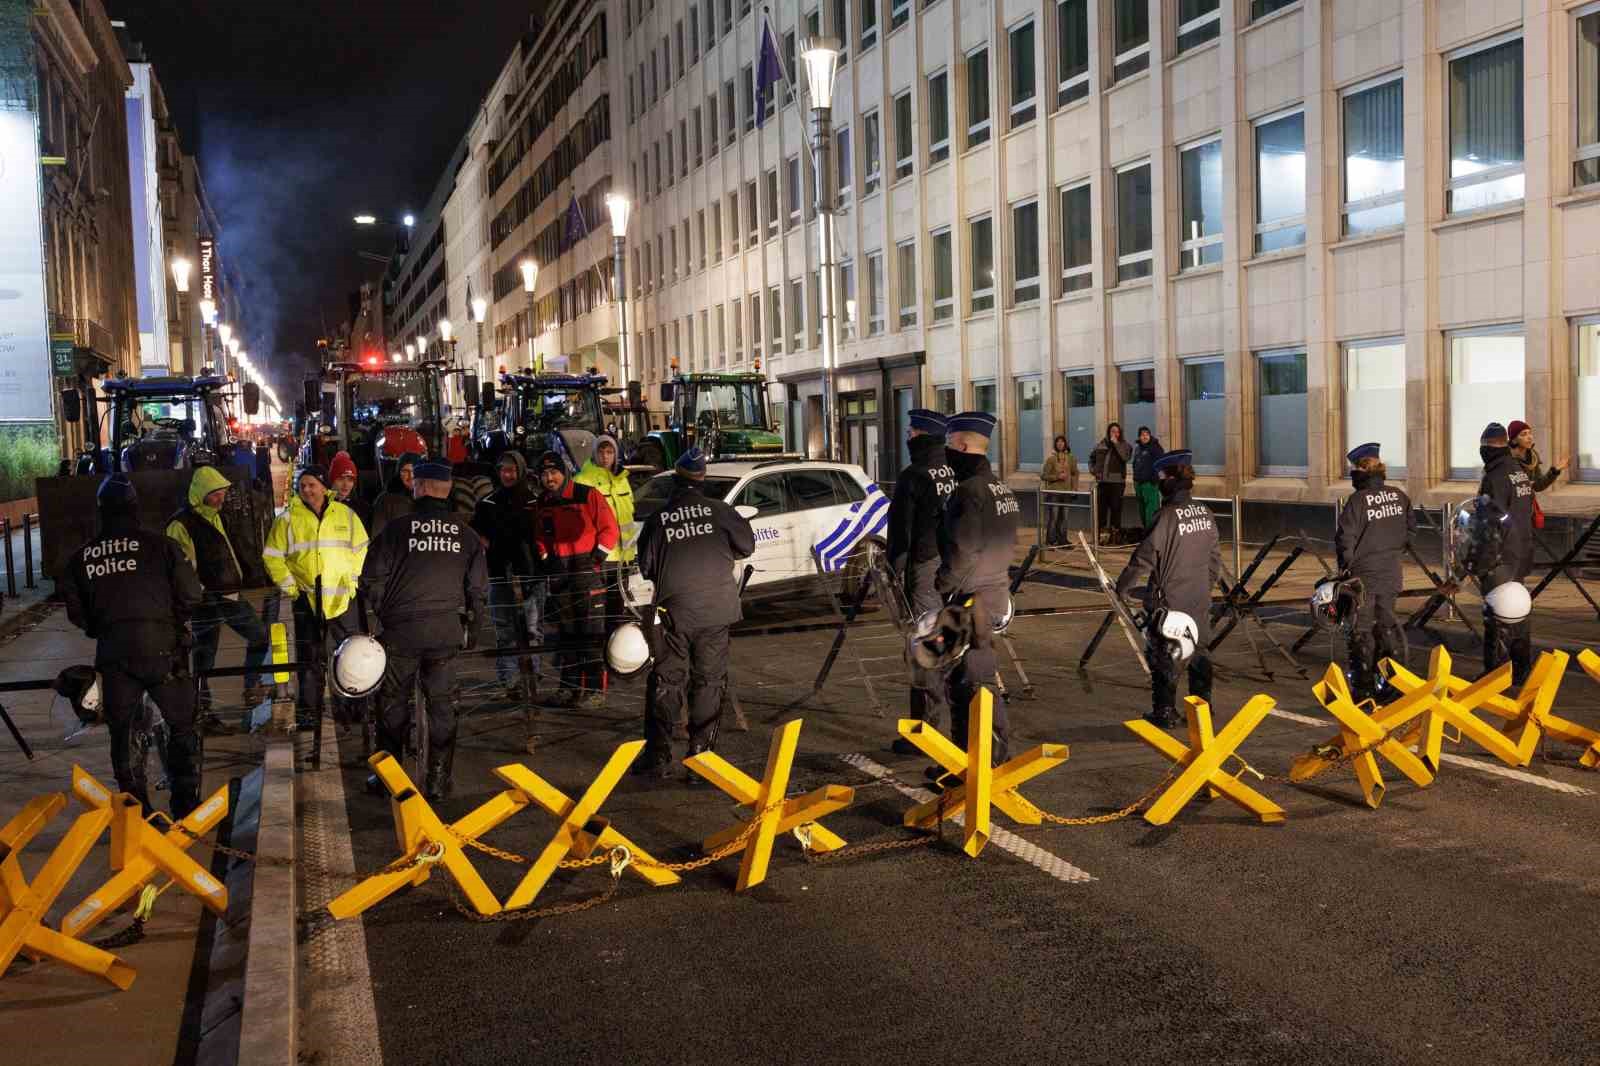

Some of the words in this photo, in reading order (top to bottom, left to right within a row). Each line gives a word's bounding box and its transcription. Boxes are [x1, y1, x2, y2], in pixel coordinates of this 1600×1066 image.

[1366, 491, 1399, 506] Police
[660, 503, 713, 526] Politie
[1175, 504, 1208, 520] Police
[1367, 503, 1404, 521] Politie
[410, 519, 459, 534] Police
[665, 522, 713, 543] Police
[752, 527, 781, 542] olitie
[1178, 517, 1212, 537] Politie
[83, 537, 140, 562] Politie
[408, 535, 461, 553] Politie
[86, 557, 137, 580] Police
